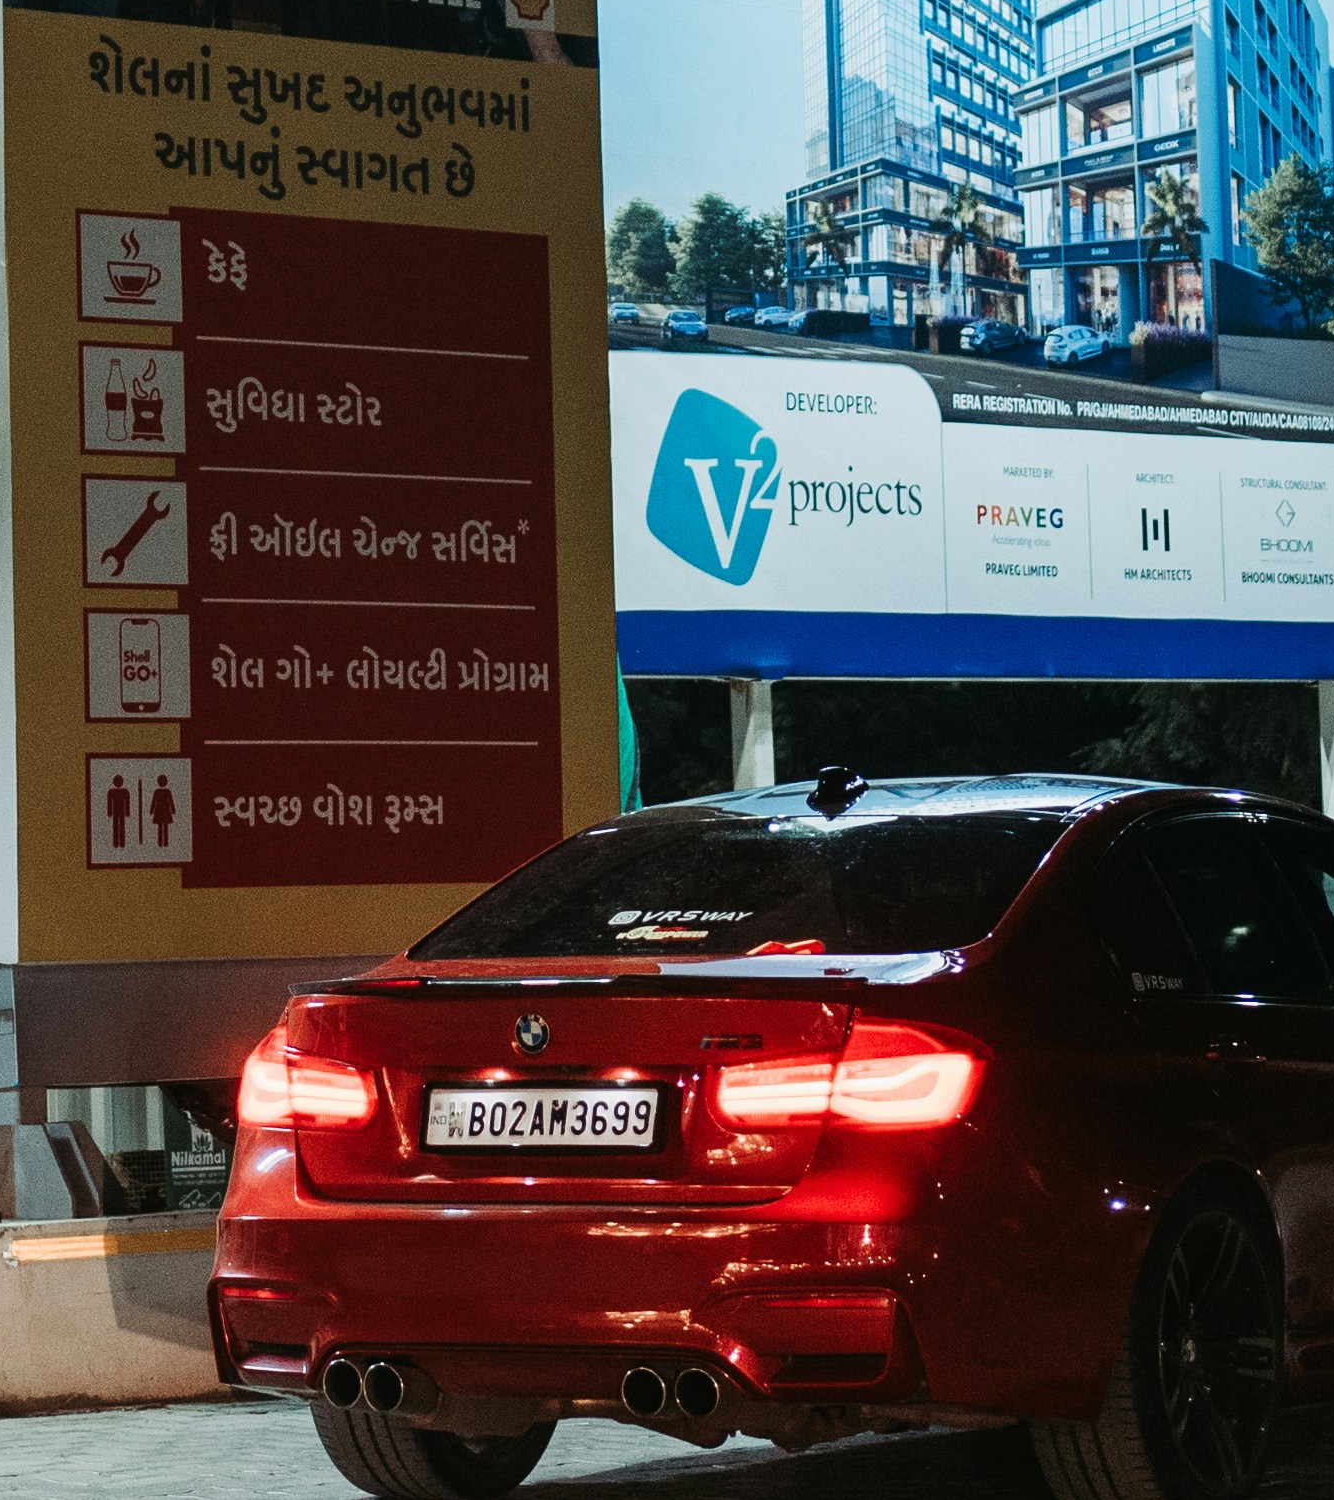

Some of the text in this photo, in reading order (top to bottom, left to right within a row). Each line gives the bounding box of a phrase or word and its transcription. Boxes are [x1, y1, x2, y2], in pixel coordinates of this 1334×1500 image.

[88, 34, 531, 139] શેલનાં સુખદ અનુભવમાં
[154, 125, 476, 201] આપનું સ્વાગત છે
[202, 238, 248, 291] કેફે
[206, 375, 382, 434] સુવિધા સ્ટોર
[785, 391, 878, 416] DEVELOPER:
[952, 393, 982, 411] RERA
[982, 396, 1056, 416] REGISTRATION
[1002, 466, 1042, 479] MARKETED
[1135, 473, 1176, 485] ARCHITECT:
[1239, 477, 1283, 490] STRUCTURAL
[788, 464, 923, 528] projects
[976, 503, 1064, 530] PRAVEG
[352, 515, 422, 560] ચેન્જ
[1260, 537, 1314, 552] BHOOMI
[985, 562, 1058, 578] PRAVEG LIMITED
[1123, 567, 1192, 582] HM ARCHITECTS
[1241, 571, 1334, 586] BHOOMI CONSULTANTS
[123, 648, 151, 663] Shell
[211, 642, 549, 692] શેલ ગો+ લોયલ્ટી પ્રોગ્રામ
[123, 664, 158, 682] GO+
[313, 782, 373, 826] વોશ
[170, 1148, 226, 1167] Nilkamal
